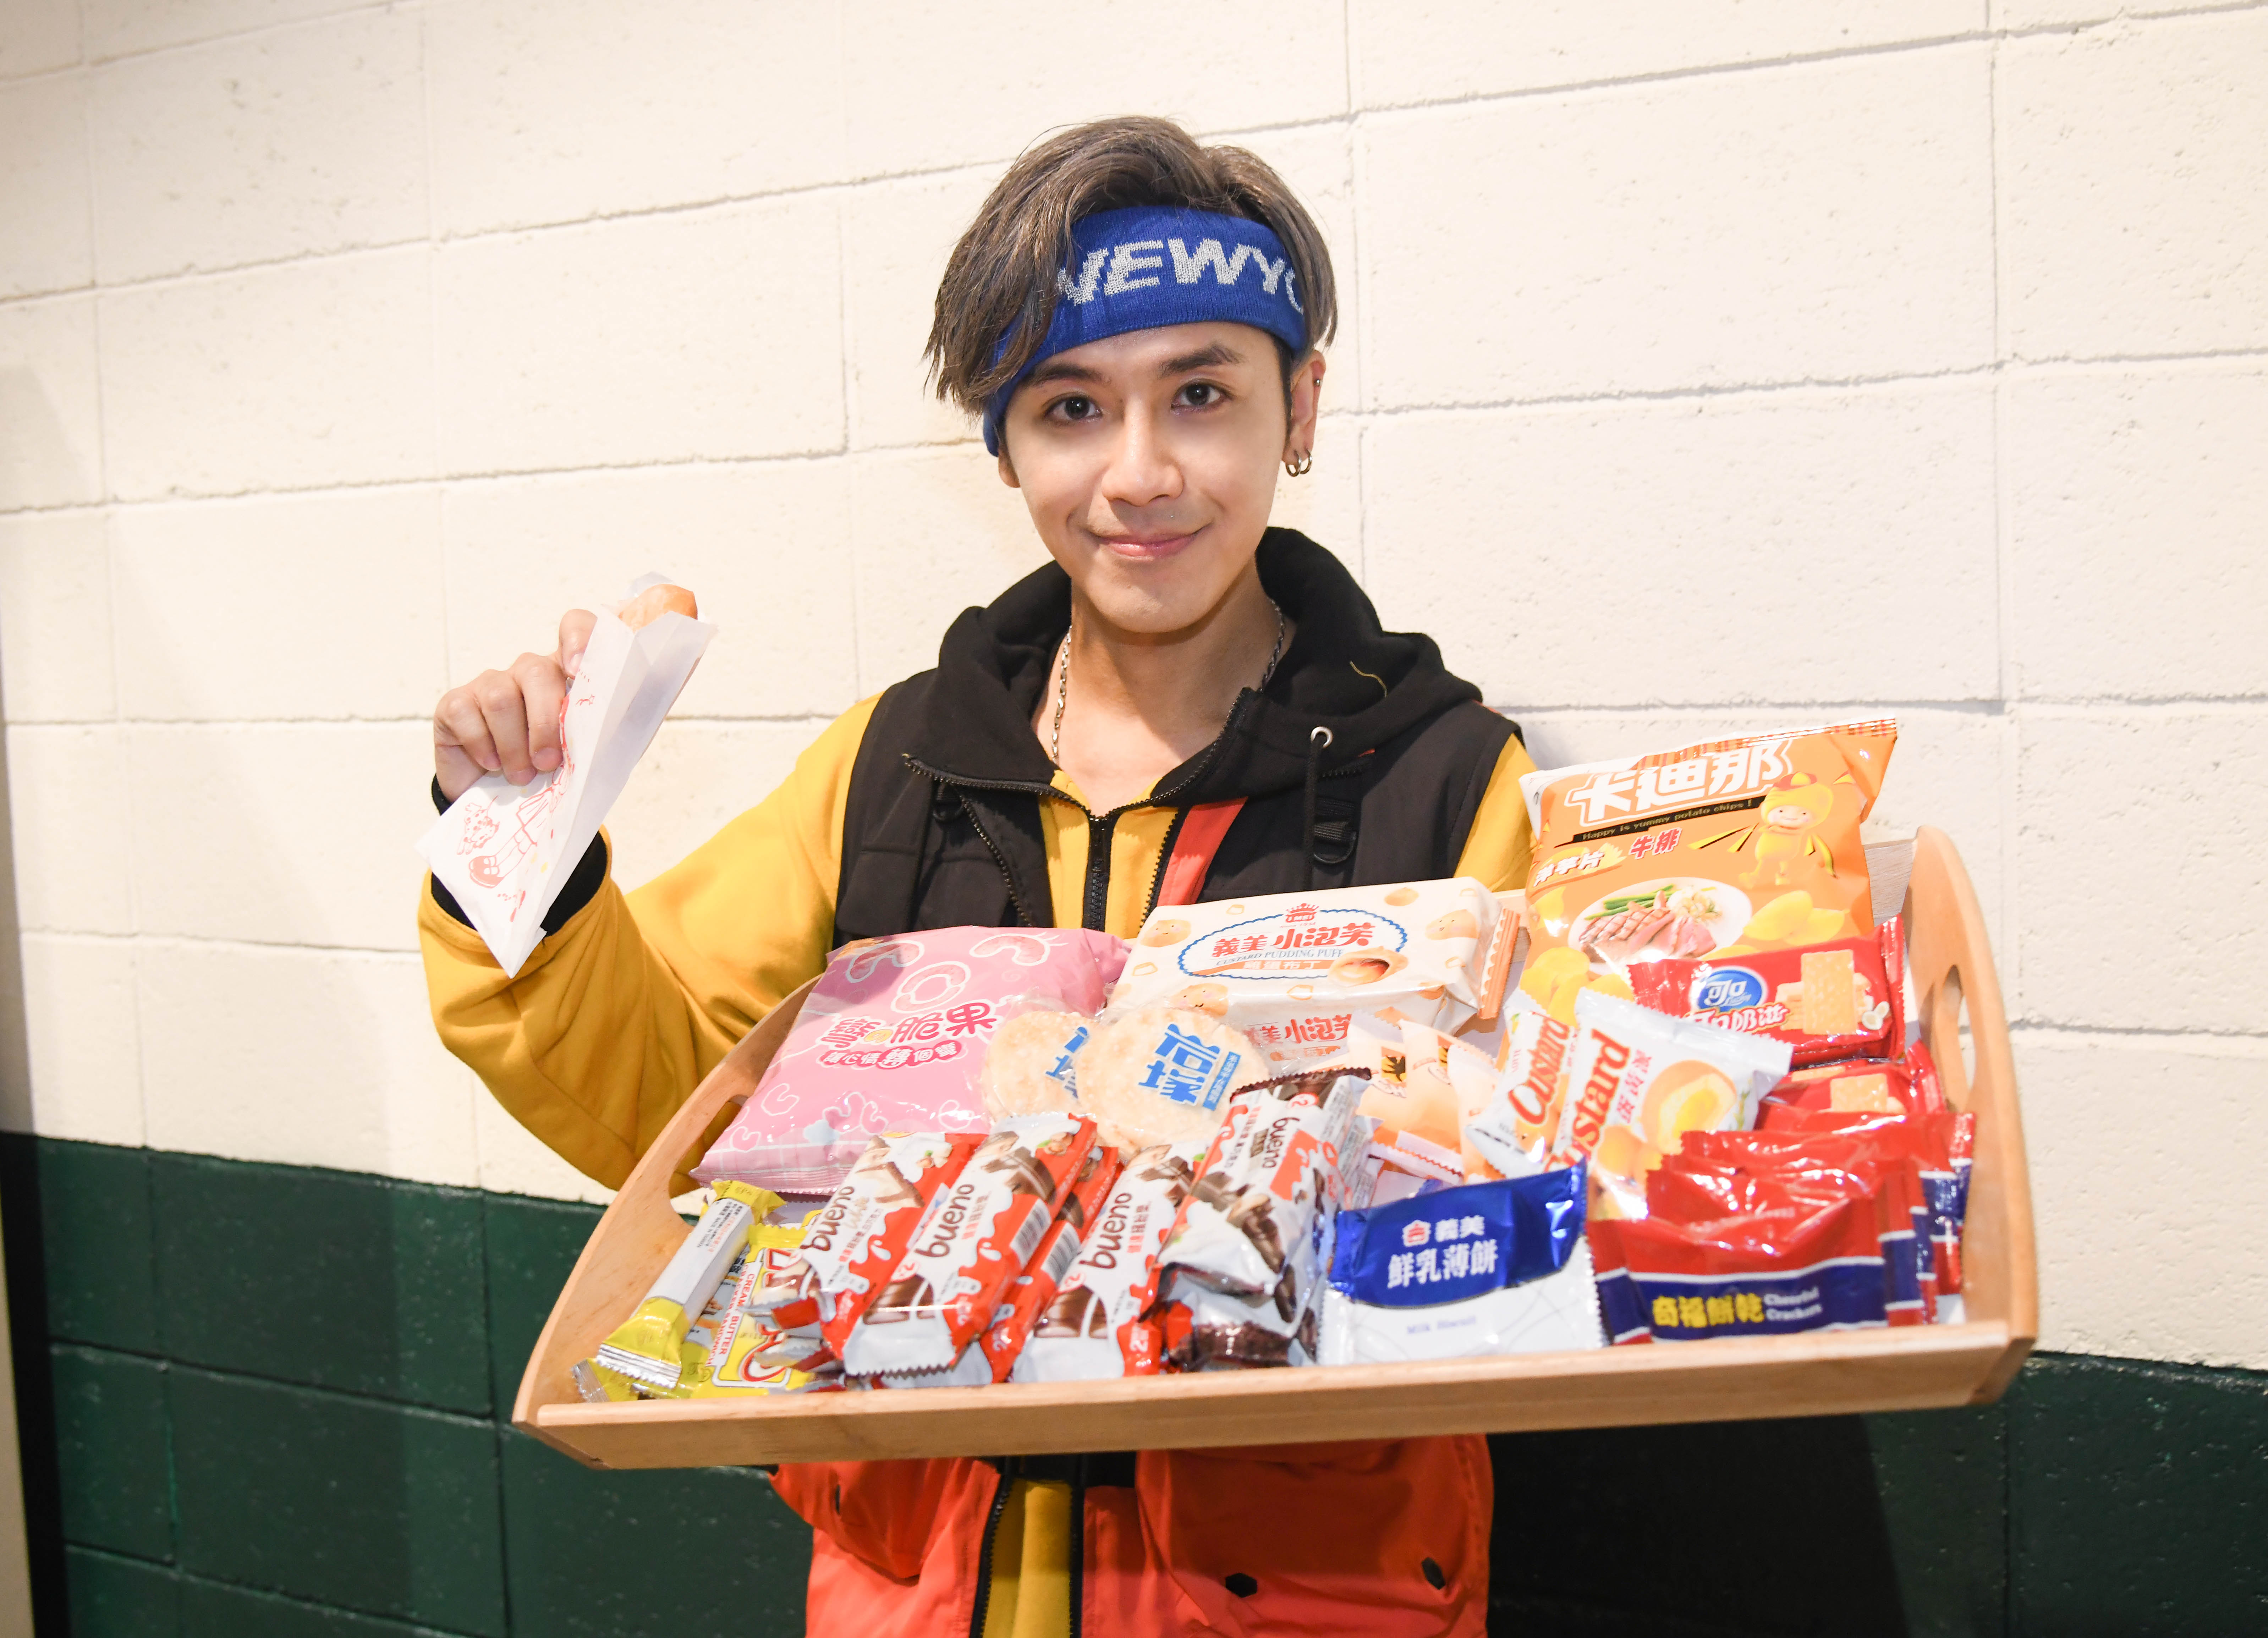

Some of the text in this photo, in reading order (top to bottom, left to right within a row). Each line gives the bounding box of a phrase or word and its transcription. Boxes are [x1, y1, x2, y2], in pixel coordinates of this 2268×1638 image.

[1056, 237, 1304, 314] NEWY
[1572, 746, 1784, 822] 卡迪那
[1583, 827, 1616, 840] Happy
[1633, 816, 1670, 829] yummy
[1674, 808, 1710, 821] potato
[1713, 802, 1744, 812] chips
[1629, 828, 1681, 859] 牛排
[1533, 850, 1605, 887] 洋芋片
[1216, 953, 1263, 966] CUSTARD
[1264, 950, 1314, 958] PUDDING
[1243, 960, 1322, 969] 雞蛋布丁
[824, 1041, 958, 1065] 讓心情轉個彎
[1262, 1116, 1300, 1168] bueno
[800, 1186, 855, 1251] bueno
[915, 1184, 975, 1258] bueno
[1079, 1193, 1132, 1269] bueno
[1387, 1238, 1499, 1289] 鮮乳薄餅
[719, 1316, 740, 1354] BUTTER
